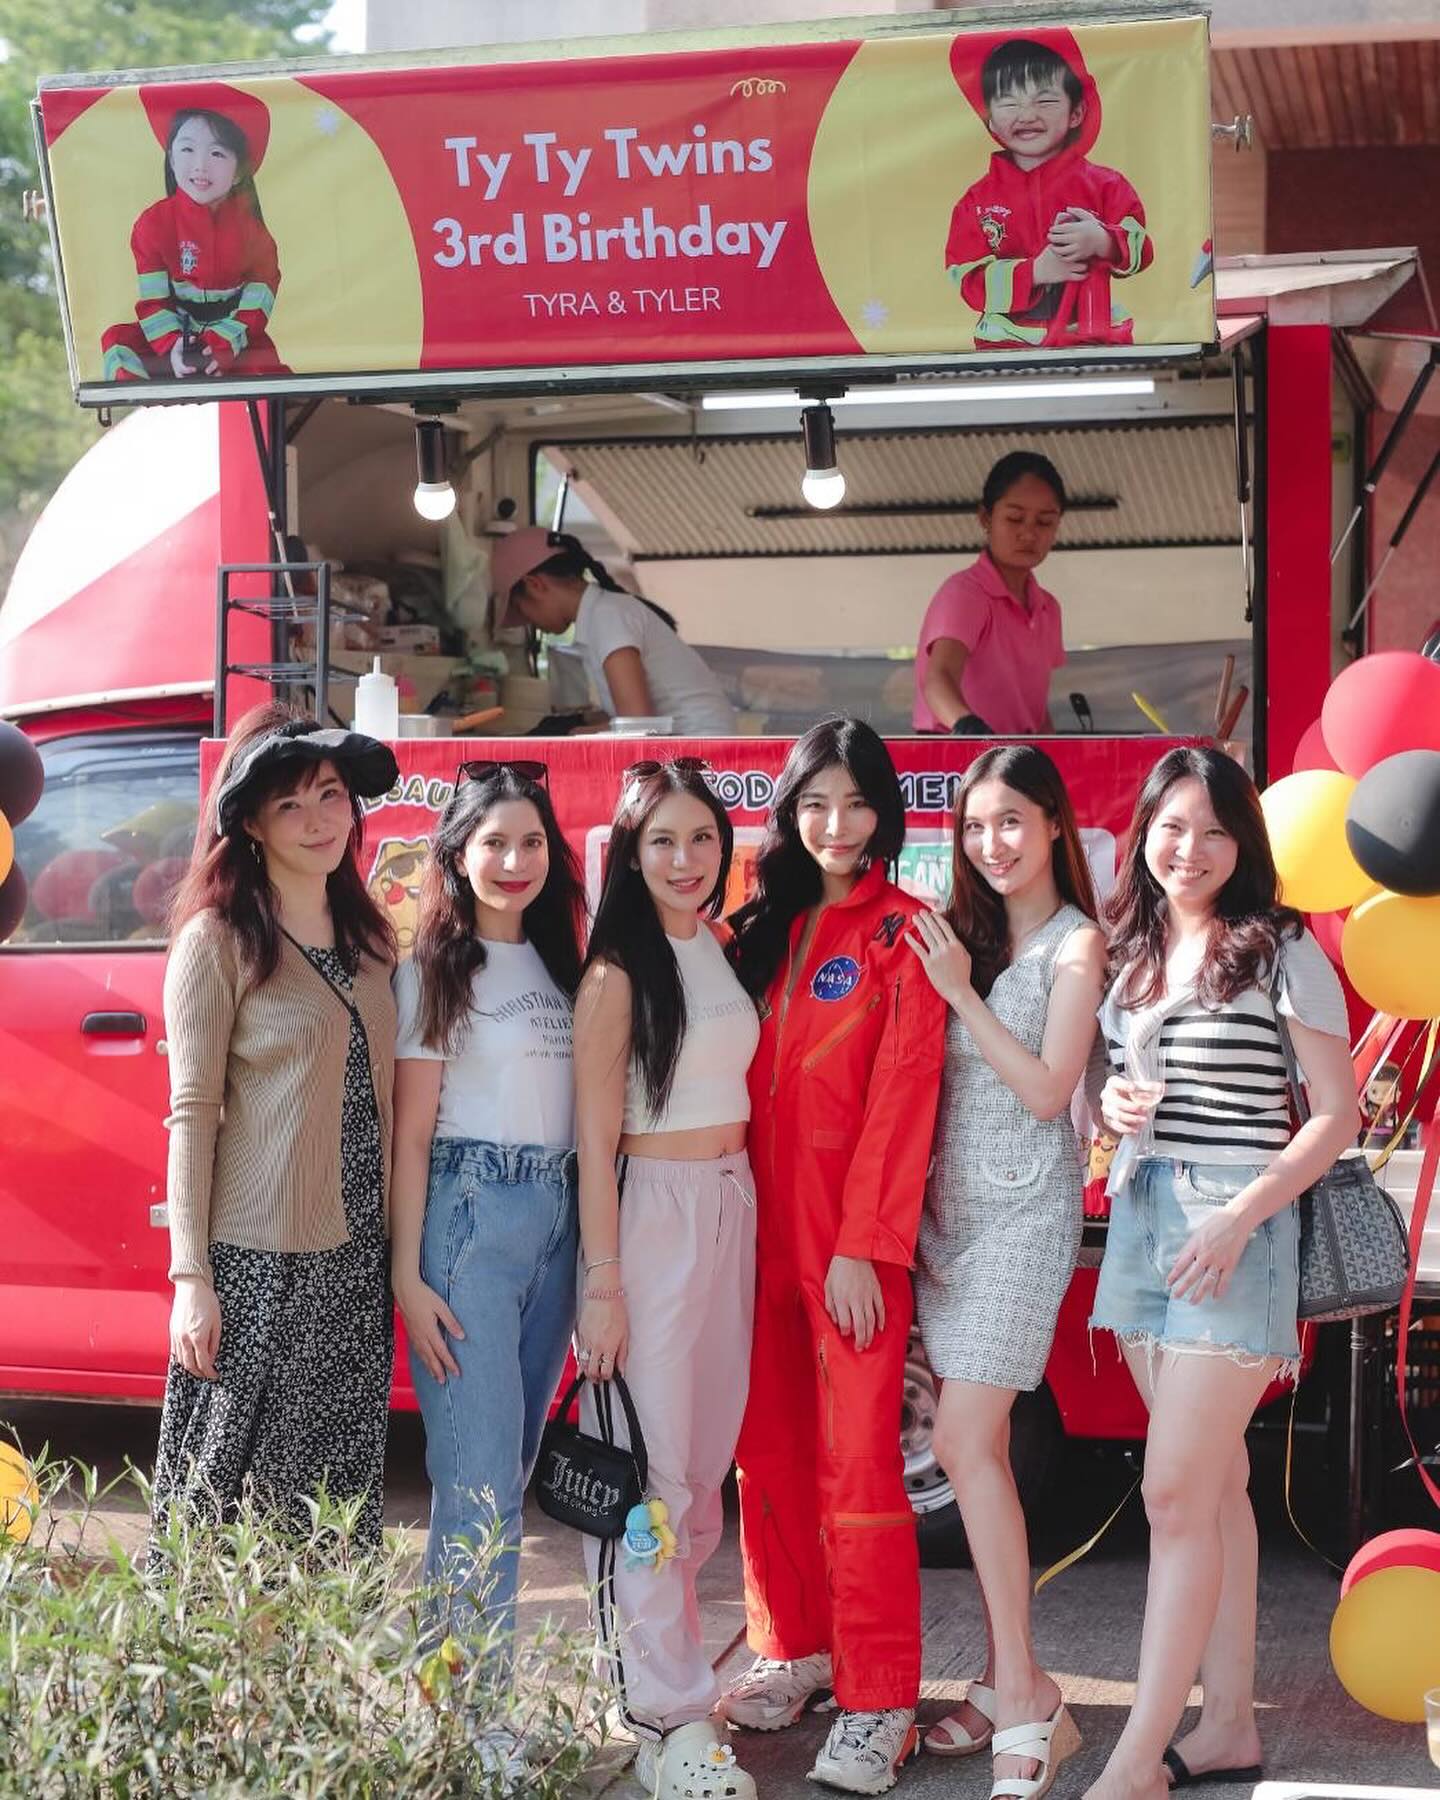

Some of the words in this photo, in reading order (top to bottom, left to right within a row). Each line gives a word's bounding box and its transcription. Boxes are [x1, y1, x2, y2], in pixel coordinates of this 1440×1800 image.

[444, 136, 512, 200] Ty
[523, 131, 593, 197] Ty
[603, 124, 774, 179] Twins
[432, 212, 528, 269] 3rd
[542, 204, 788, 269] Birthday
[523, 292, 601, 317] TYRA
[607, 290, 628, 315] &
[632, 286, 722, 313] TYLER
[817, 971, 853, 987] NASA
